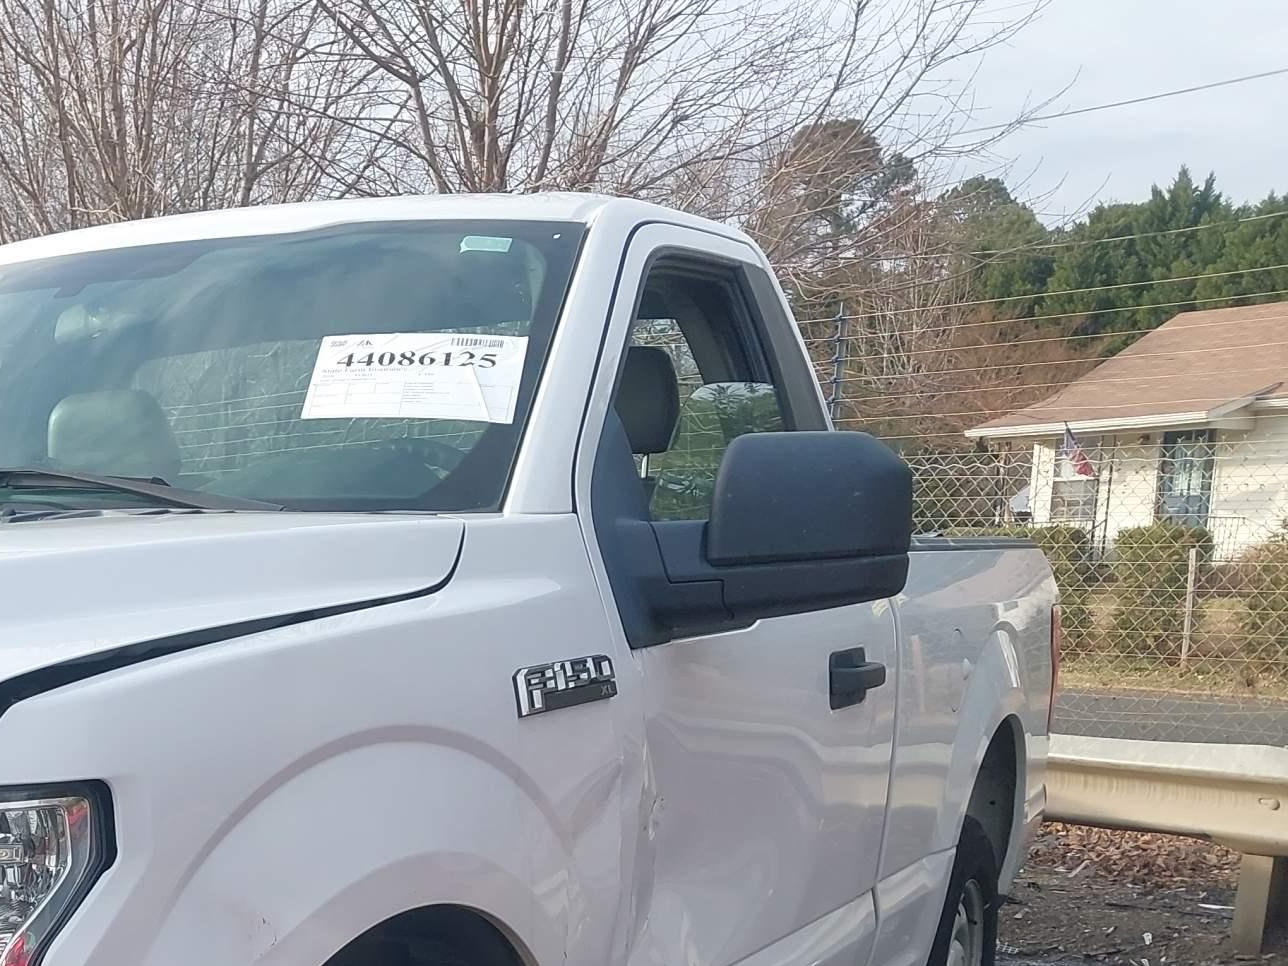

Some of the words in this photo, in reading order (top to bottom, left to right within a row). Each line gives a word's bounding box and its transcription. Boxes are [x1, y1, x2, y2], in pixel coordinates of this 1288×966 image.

[337, 350, 498, 368] 44086125
[512, 655, 615, 717] F-150
[601, 685, 615, 696] XL
